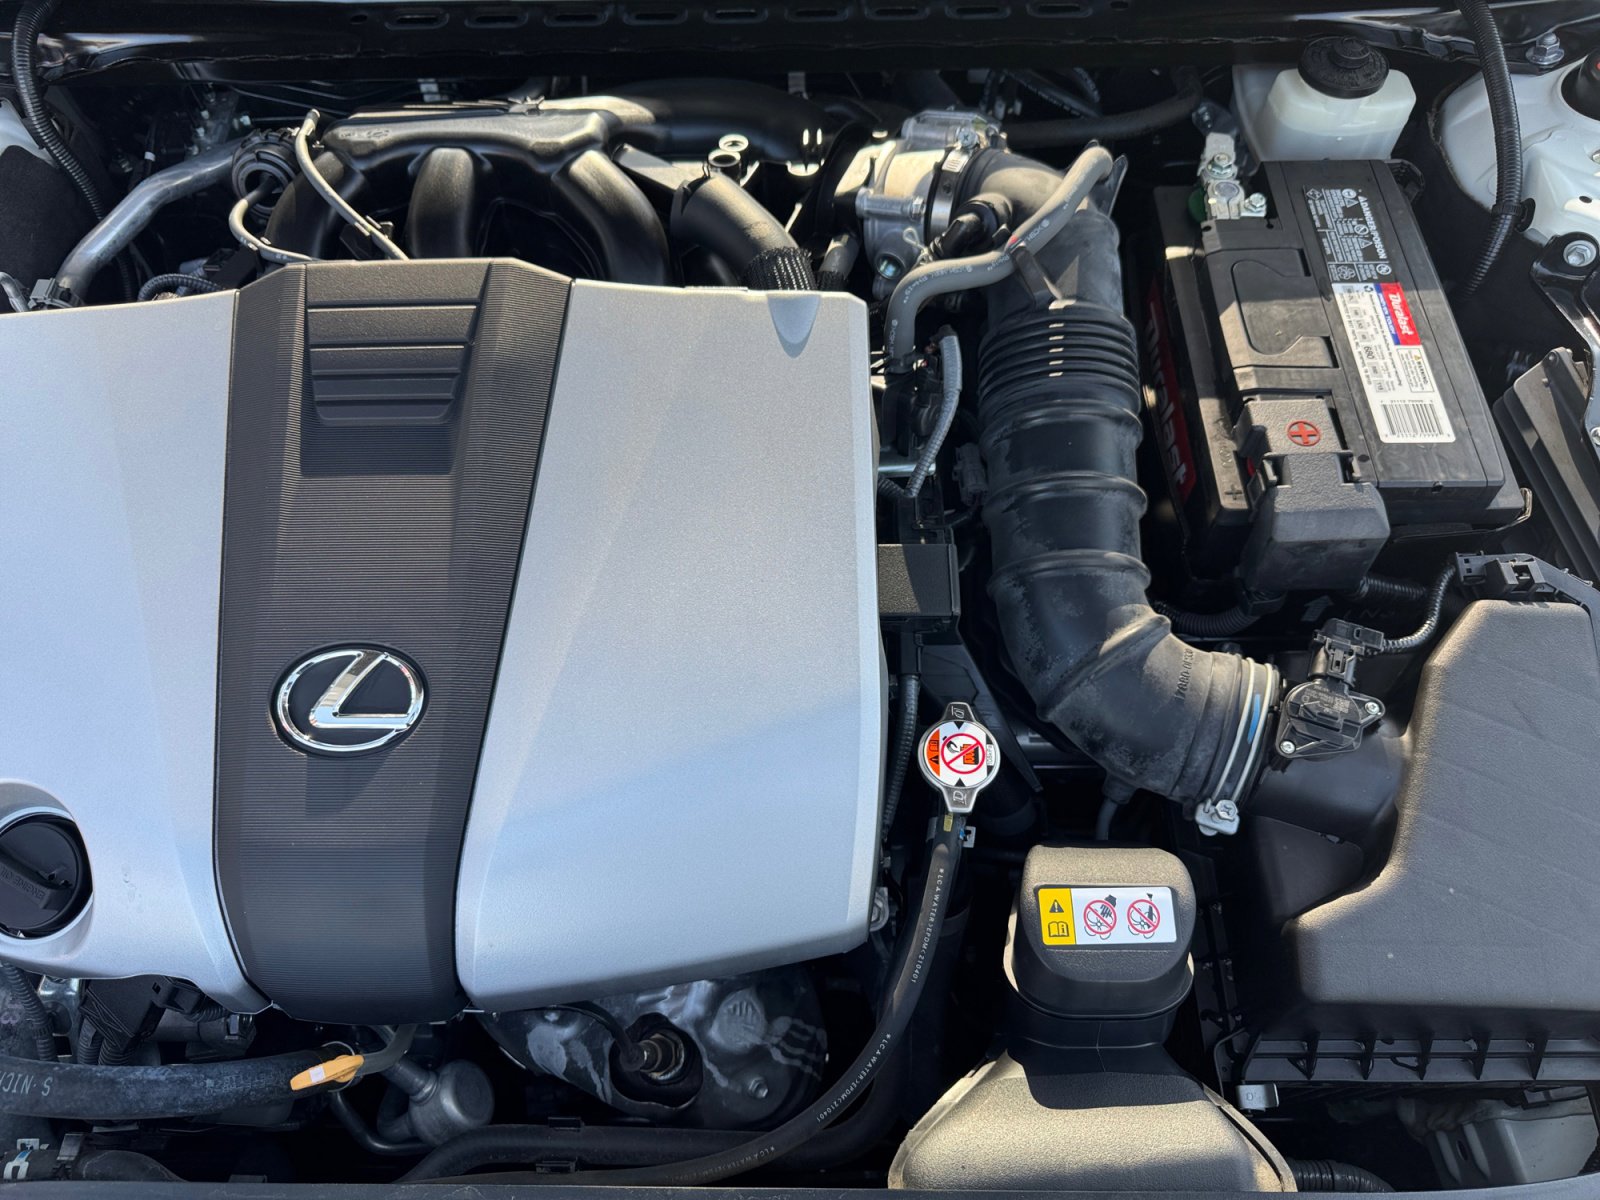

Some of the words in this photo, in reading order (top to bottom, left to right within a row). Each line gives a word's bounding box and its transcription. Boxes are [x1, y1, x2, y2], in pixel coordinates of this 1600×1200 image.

[1361, 202, 1387, 259] DANGER/POISON
[1391, 293, 1414, 335] Duralast
[1362, 345, 1375, 359] 680
[1146, 301, 1188, 486] Duralast
